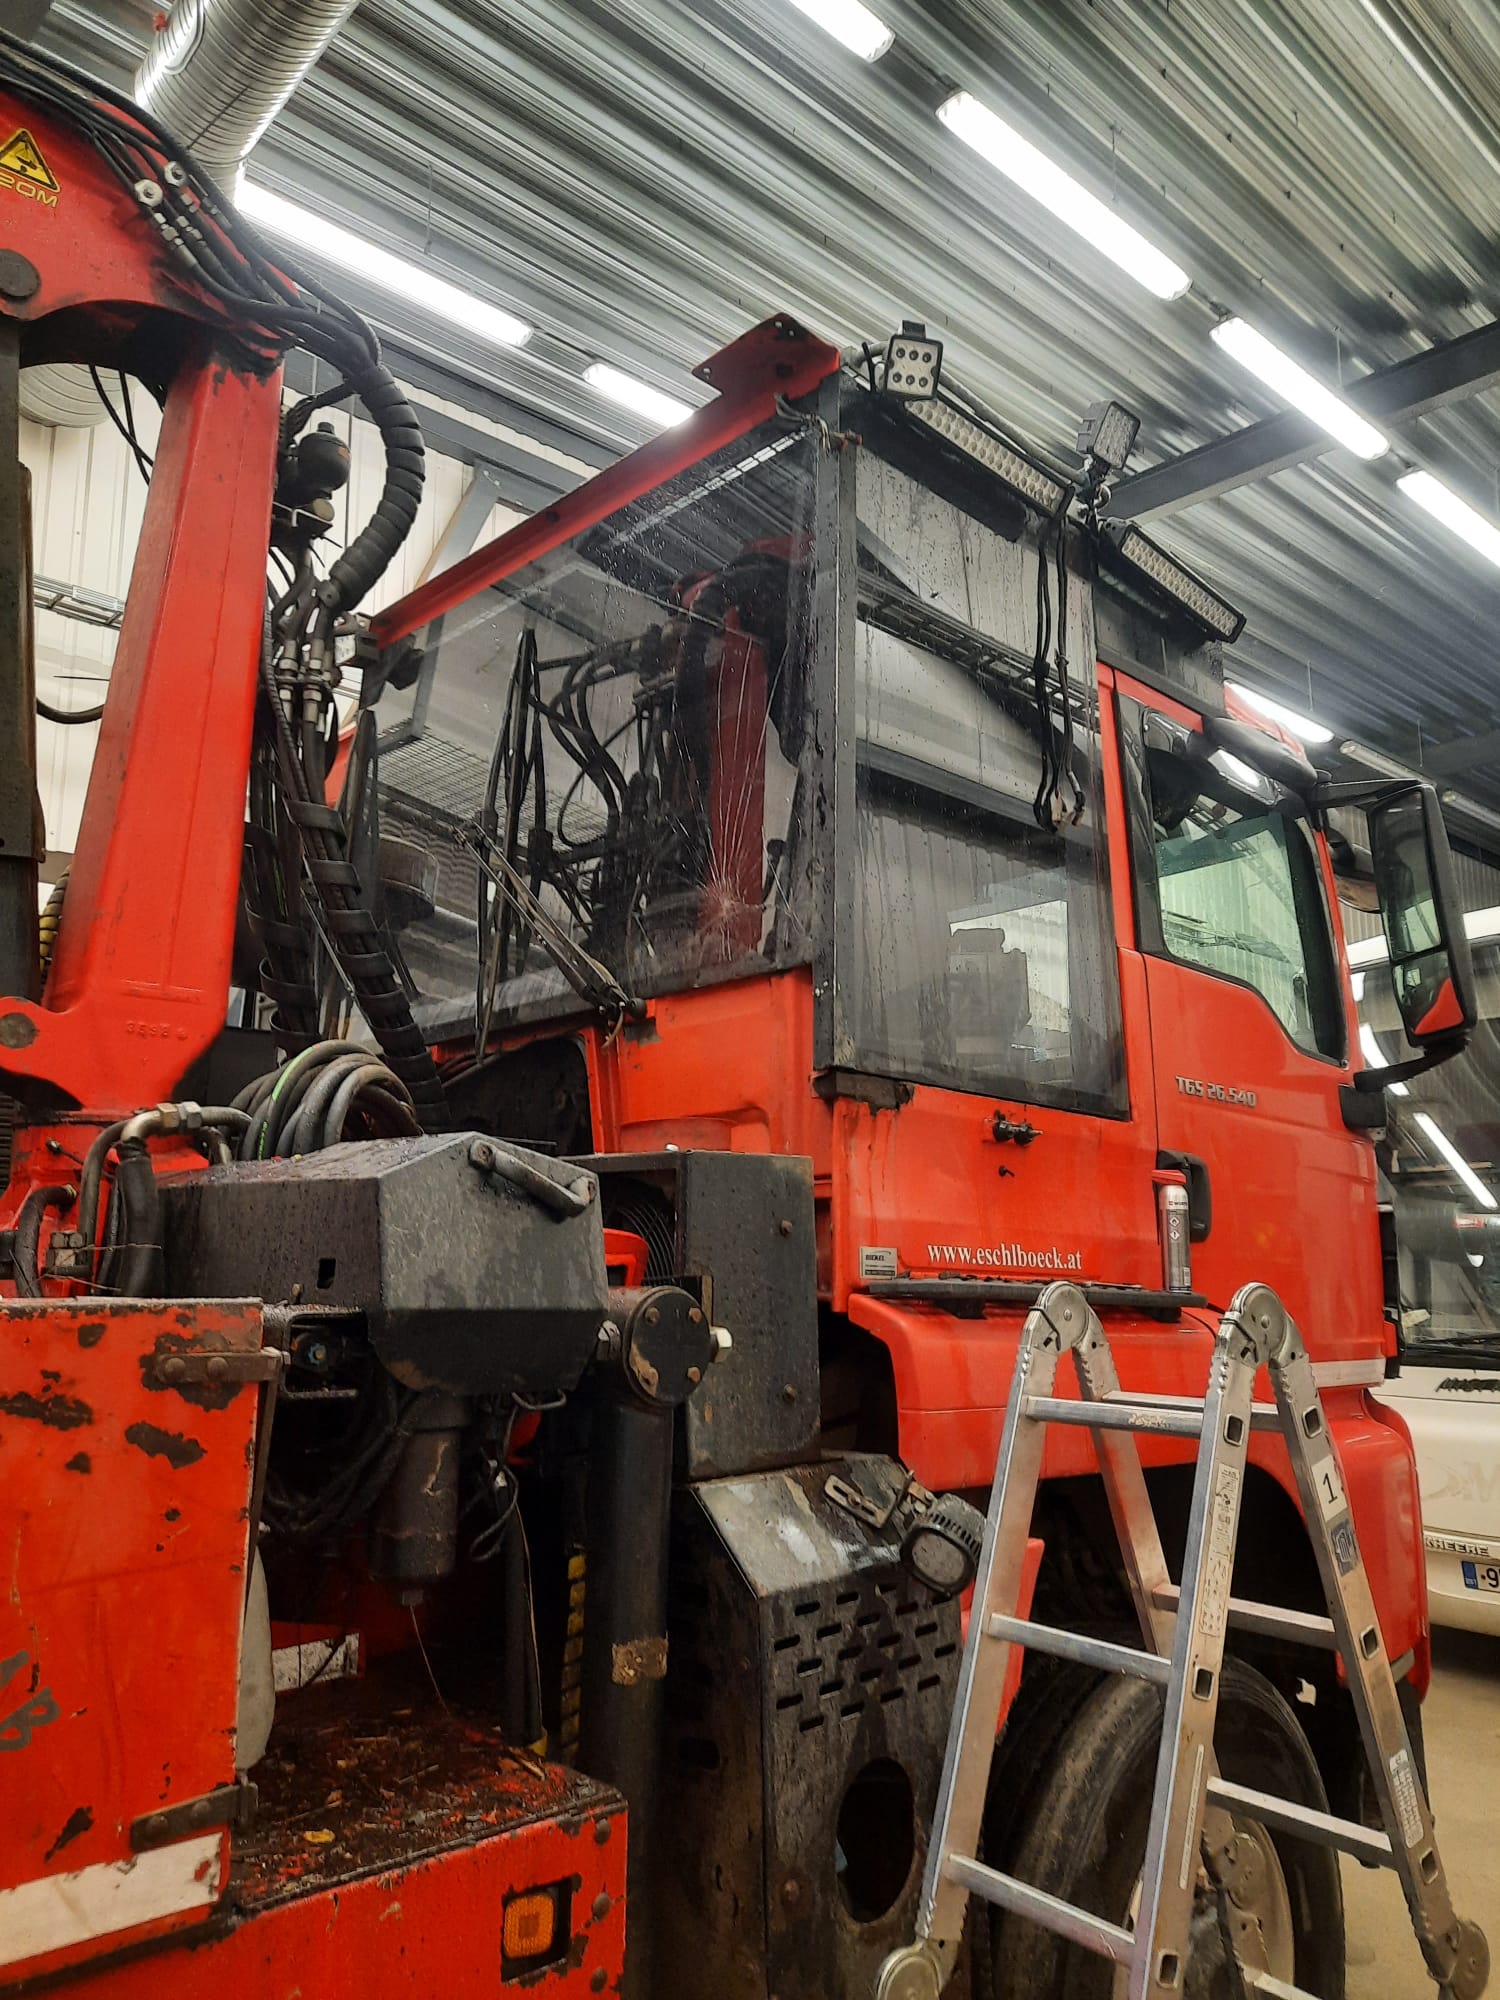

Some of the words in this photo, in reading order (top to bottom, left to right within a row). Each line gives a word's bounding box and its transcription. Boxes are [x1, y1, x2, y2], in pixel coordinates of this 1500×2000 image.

[1176, 1076, 1204, 1097] TGS
[1207, 1083, 1256, 1107] 26.540
[927, 1243, 1082, 1270] www.eschlboeck.at
[1322, 1473, 1338, 1504] 1
[1486, 1567, 1500, 1588] 9
